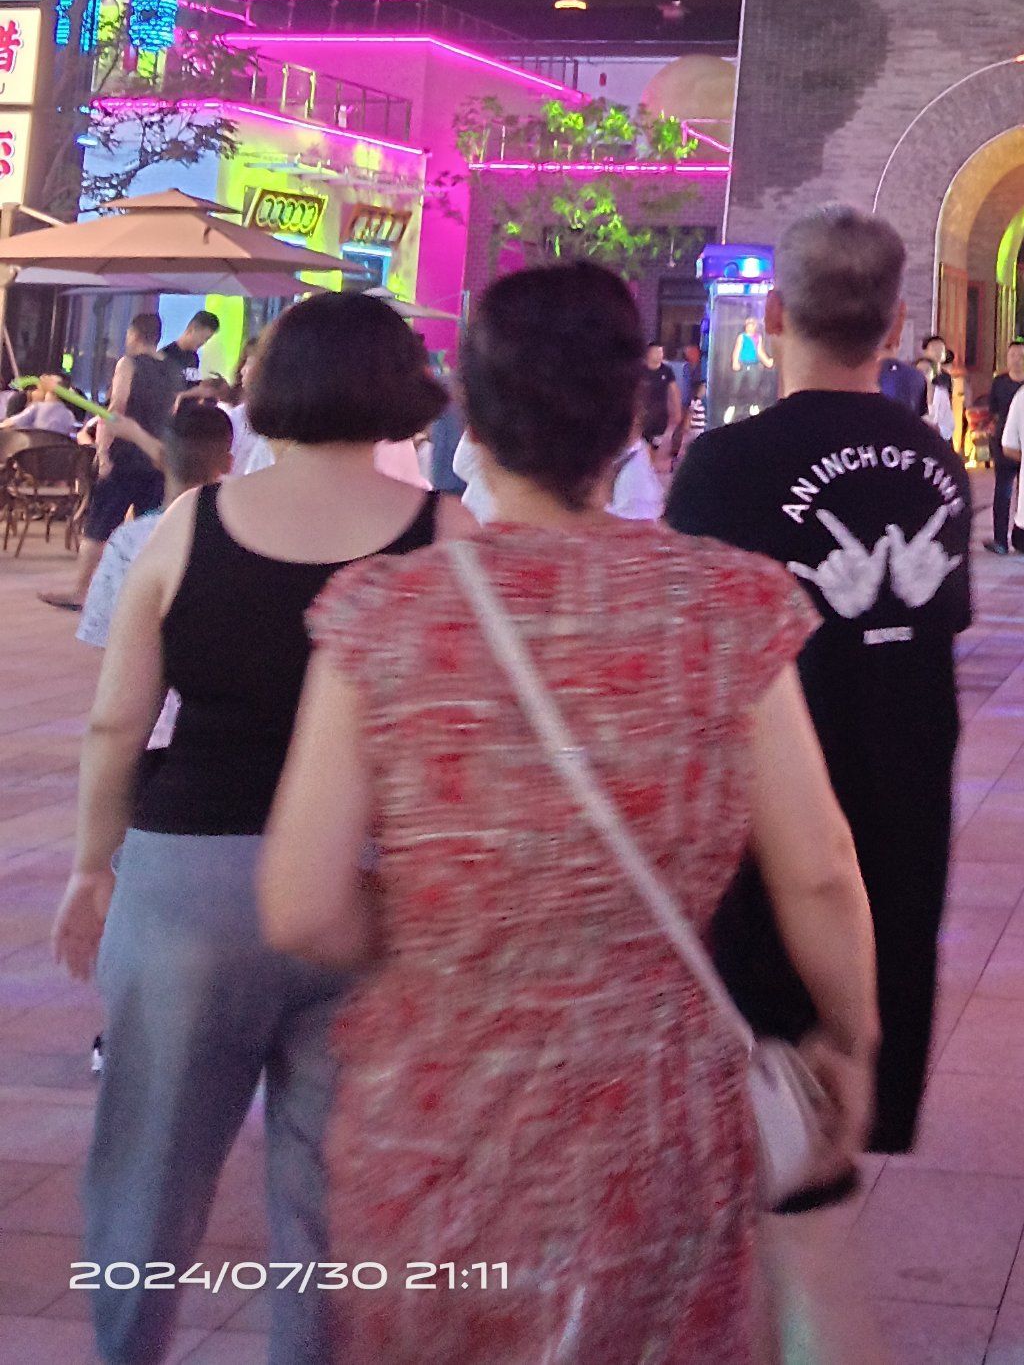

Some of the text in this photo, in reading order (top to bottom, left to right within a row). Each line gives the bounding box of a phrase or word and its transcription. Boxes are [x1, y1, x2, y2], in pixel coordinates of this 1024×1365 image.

[782, 477, 821, 524] AN
[811, 444, 879, 485] INCH
[881, 445, 917, 471] OF
